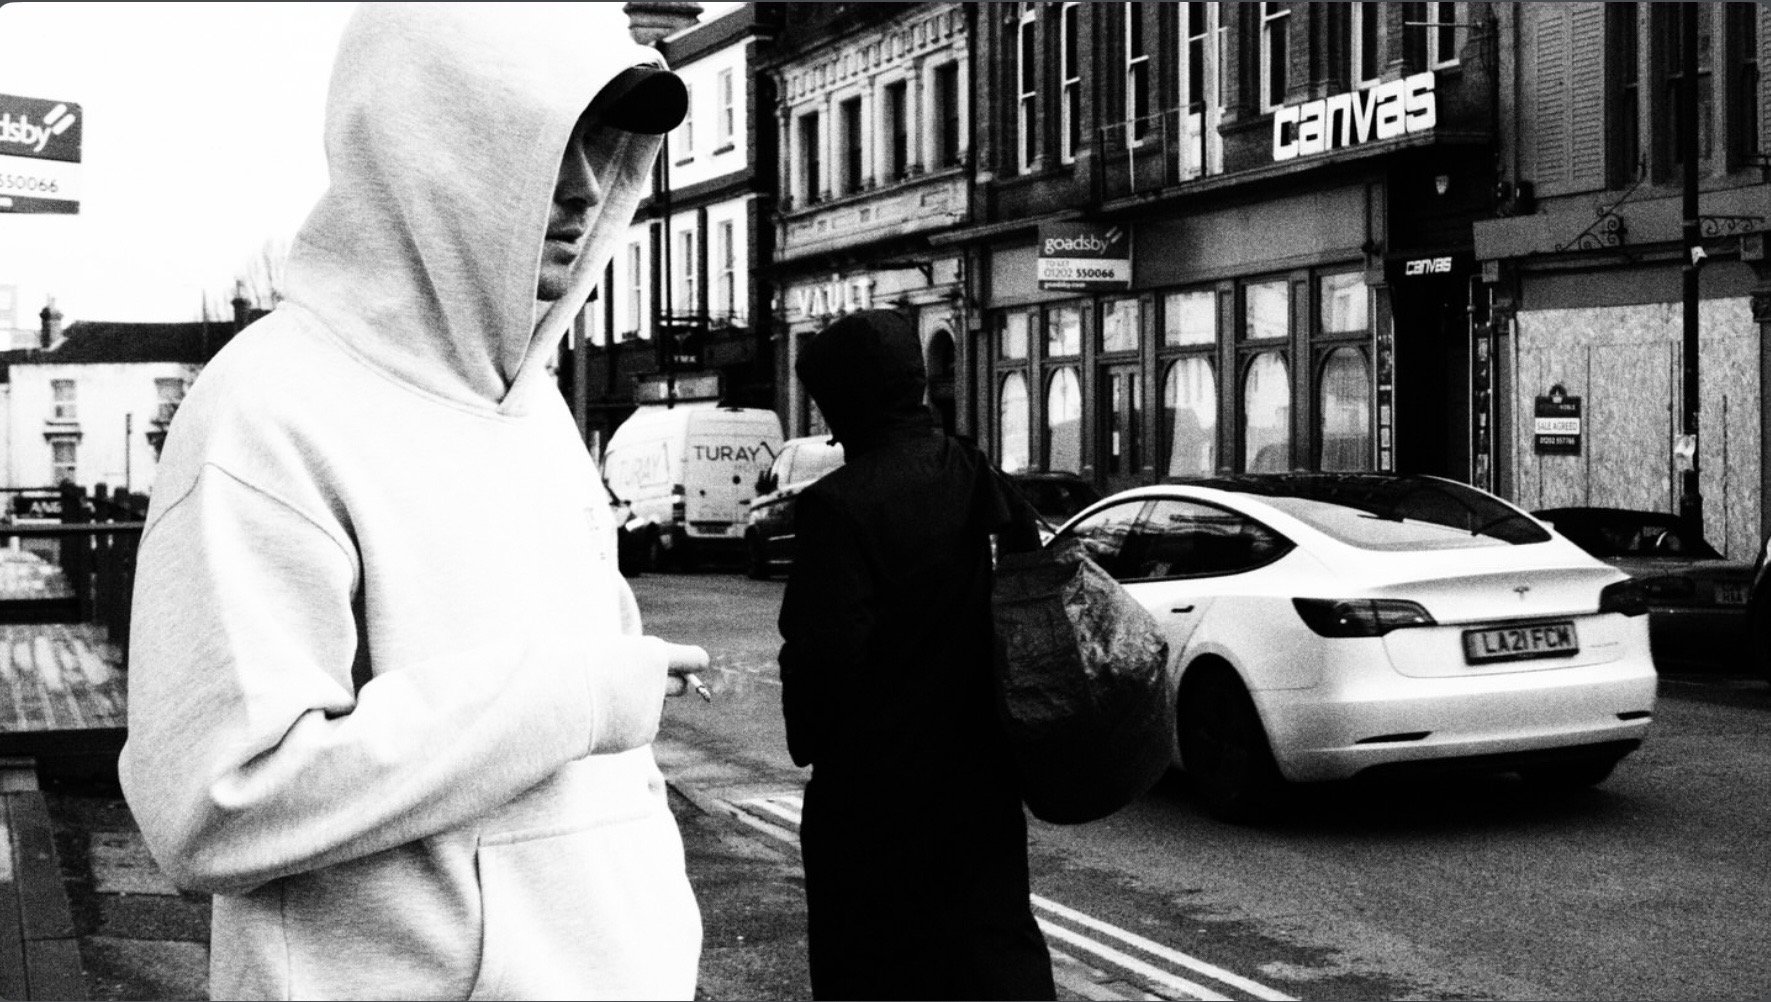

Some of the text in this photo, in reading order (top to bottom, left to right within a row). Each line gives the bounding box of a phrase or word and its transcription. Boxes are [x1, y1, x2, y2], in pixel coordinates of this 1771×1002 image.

[1273, 71, 1436, 162] canvas
[1044, 234, 1109, 255] goadsby
[1043, 268, 1115, 279] 01202 550066
[1405, 256, 1452, 276] canvas
[796, 276, 872, 316] VAULT
[1537, 421, 1578, 431] SALE AGREED
[693, 445, 760, 462] TURAY
